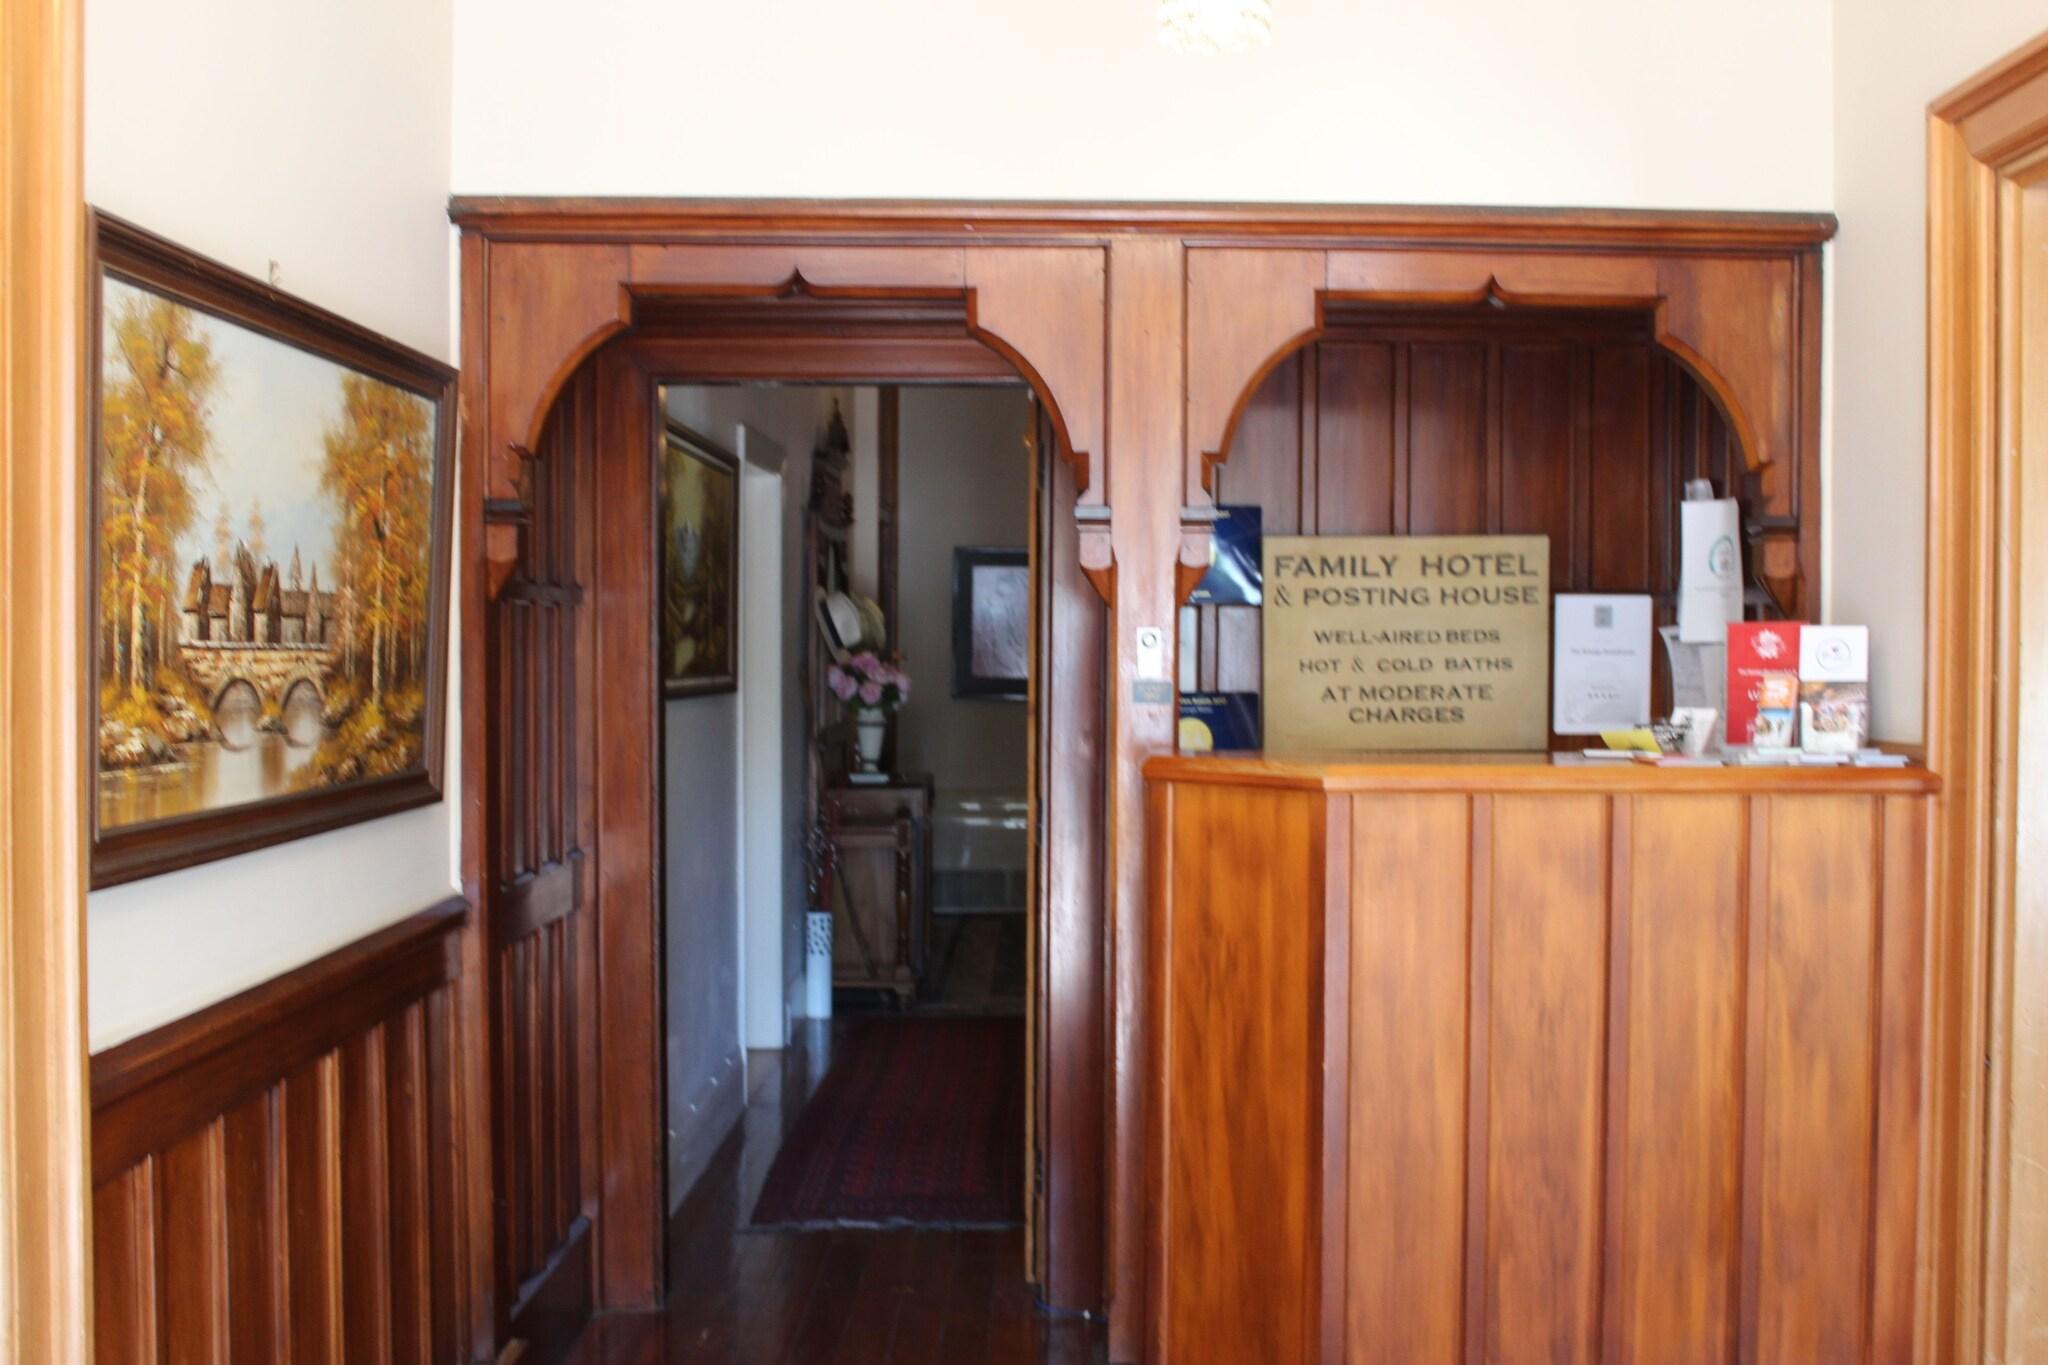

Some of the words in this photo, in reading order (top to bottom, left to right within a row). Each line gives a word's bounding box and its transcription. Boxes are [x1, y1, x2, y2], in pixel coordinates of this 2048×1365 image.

[1274, 555, 1397, 578] FAMILY
[1421, 553, 1539, 577] HOTEL
[1275, 586, 1293, 608] &
[1303, 586, 1430, 607] POSTING
[1440, 586, 1540, 606] HOUSE
[1446, 629, 1501, 645] BEDS
[1299, 658, 1341, 674] HOT
[1351, 656, 1365, 673] &
[1377, 658, 1433, 672] COLD
[1444, 658, 1513, 672] BATHS
[1321, 685, 1352, 702] AT
[1359, 684, 1494, 701] MODERATE
[1348, 706, 1465, 724] CHARGES
